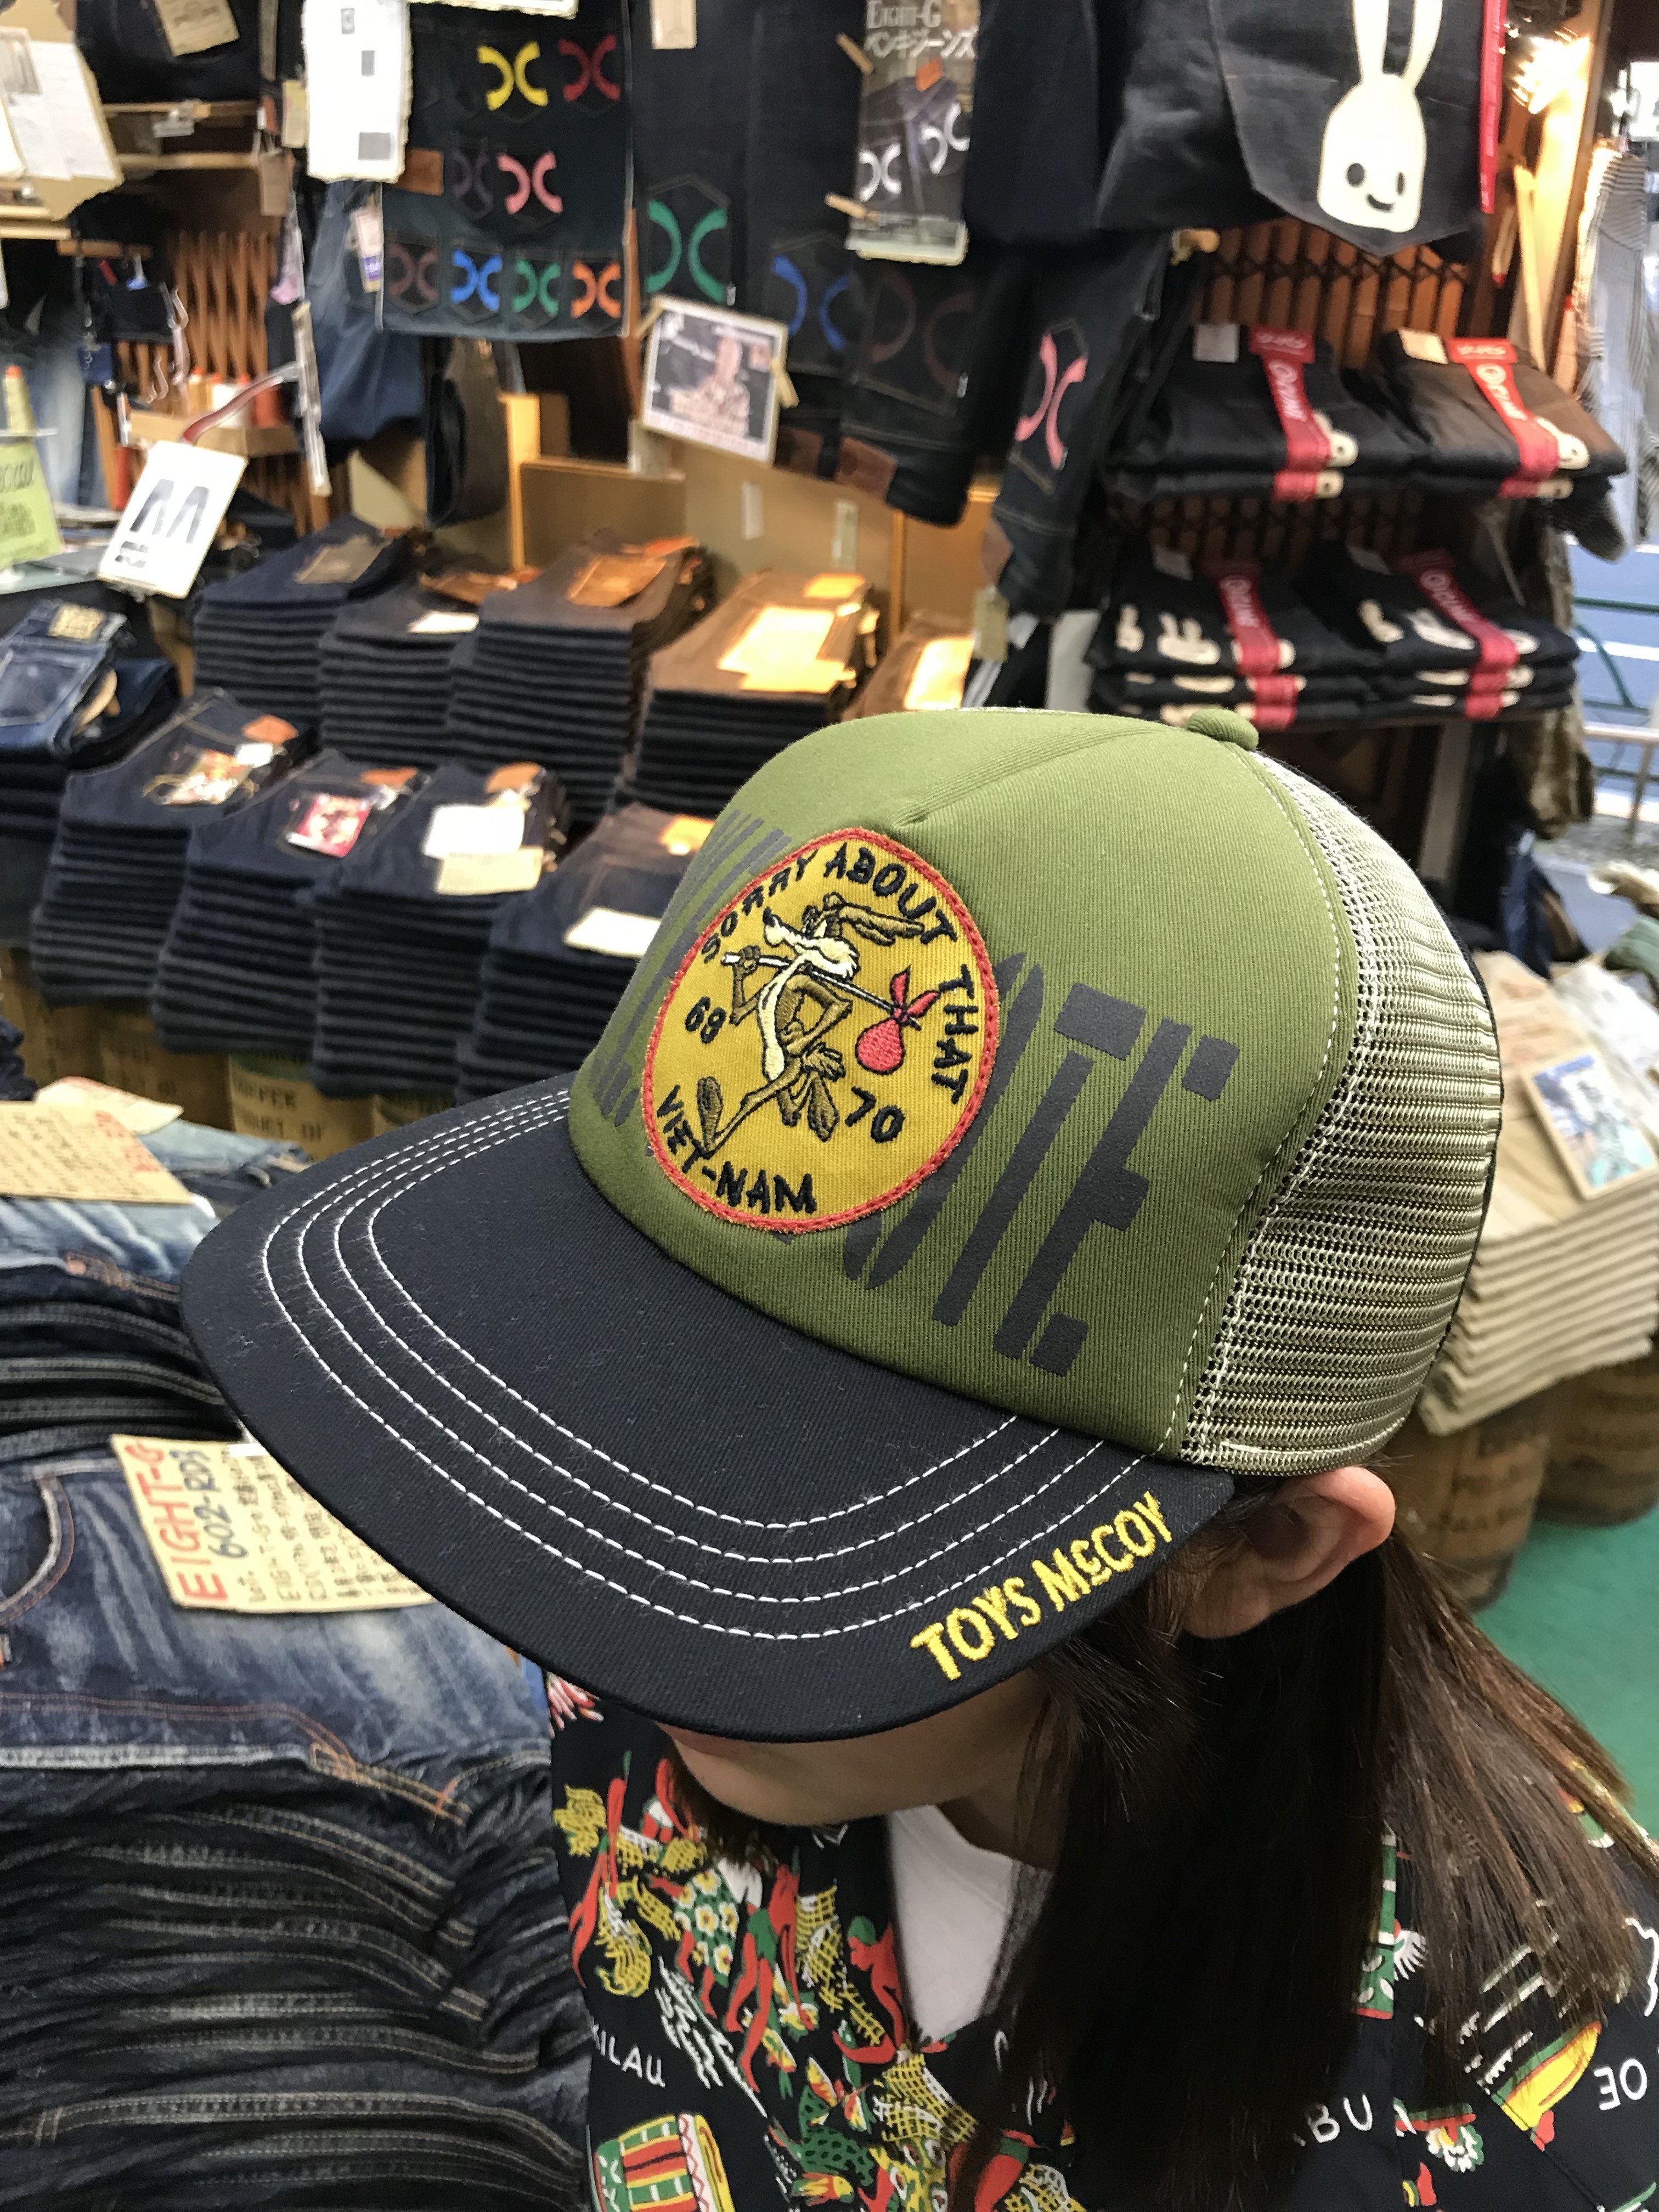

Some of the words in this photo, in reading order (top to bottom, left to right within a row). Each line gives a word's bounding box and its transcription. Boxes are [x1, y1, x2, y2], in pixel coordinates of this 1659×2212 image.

[701, 849, 818, 963] SORRY
[823, 842, 957, 945] ABOUT
[933, 964, 978, 1104] THAT
[657, 1085, 818, 1214] VIET-NAM
[845, 1086, 906, 1143] 70
[125, 1441, 228, 1600] EIGHT-G
[911, 1577, 1041, 1680] TOYS
[1293, 2093, 1373, 2143] BU
